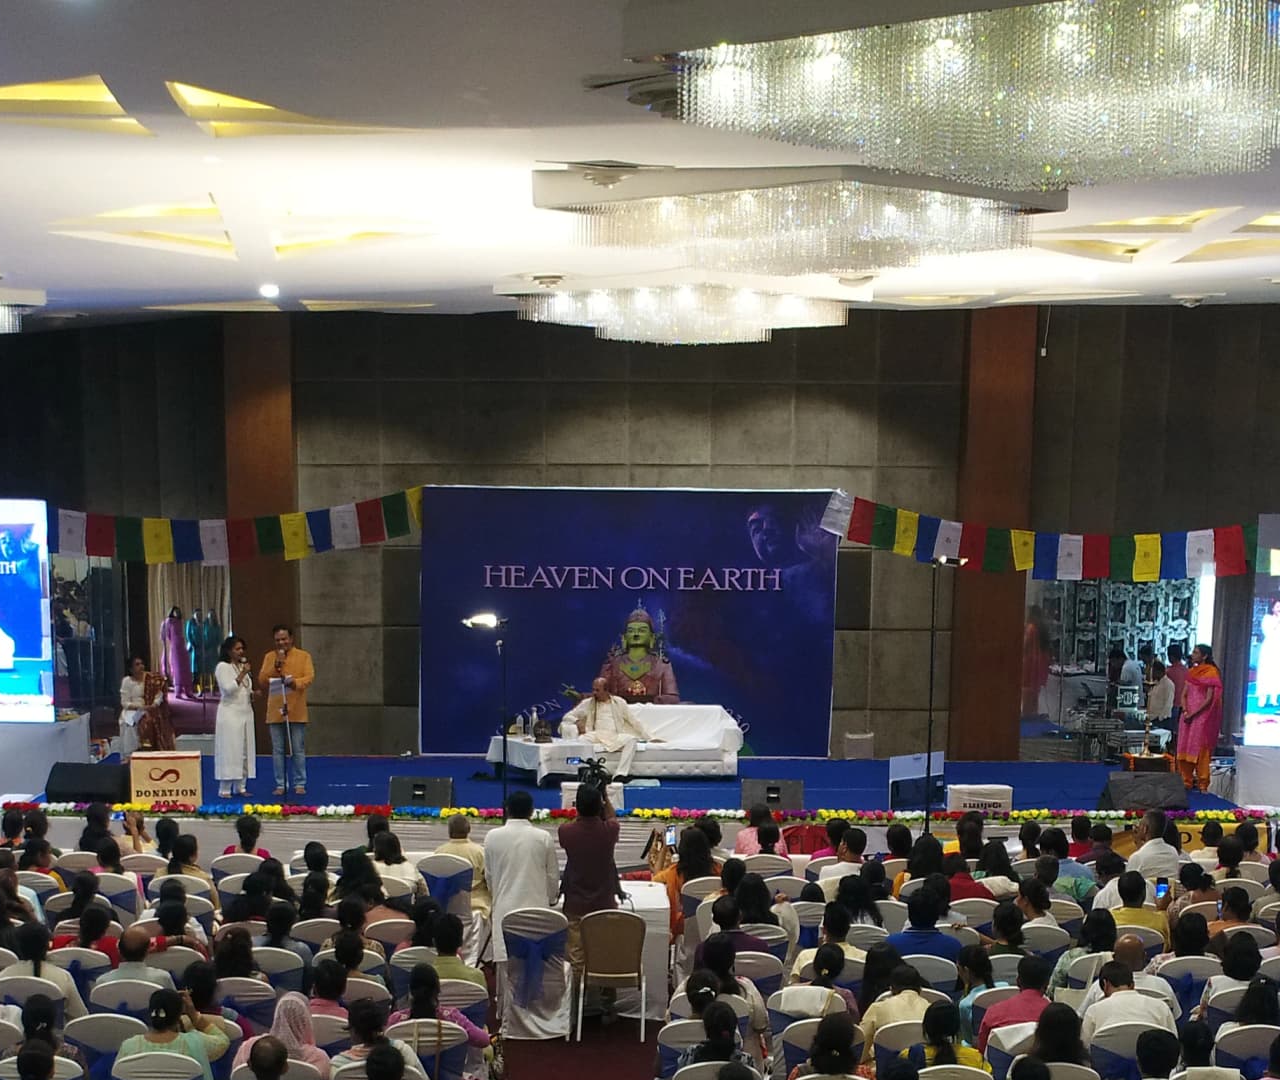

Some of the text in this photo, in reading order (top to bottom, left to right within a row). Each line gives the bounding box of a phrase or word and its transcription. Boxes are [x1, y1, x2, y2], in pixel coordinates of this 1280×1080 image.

[483, 565, 782, 591] HEAVEN ON EARTH
[136, 789, 197, 797] DONATION
